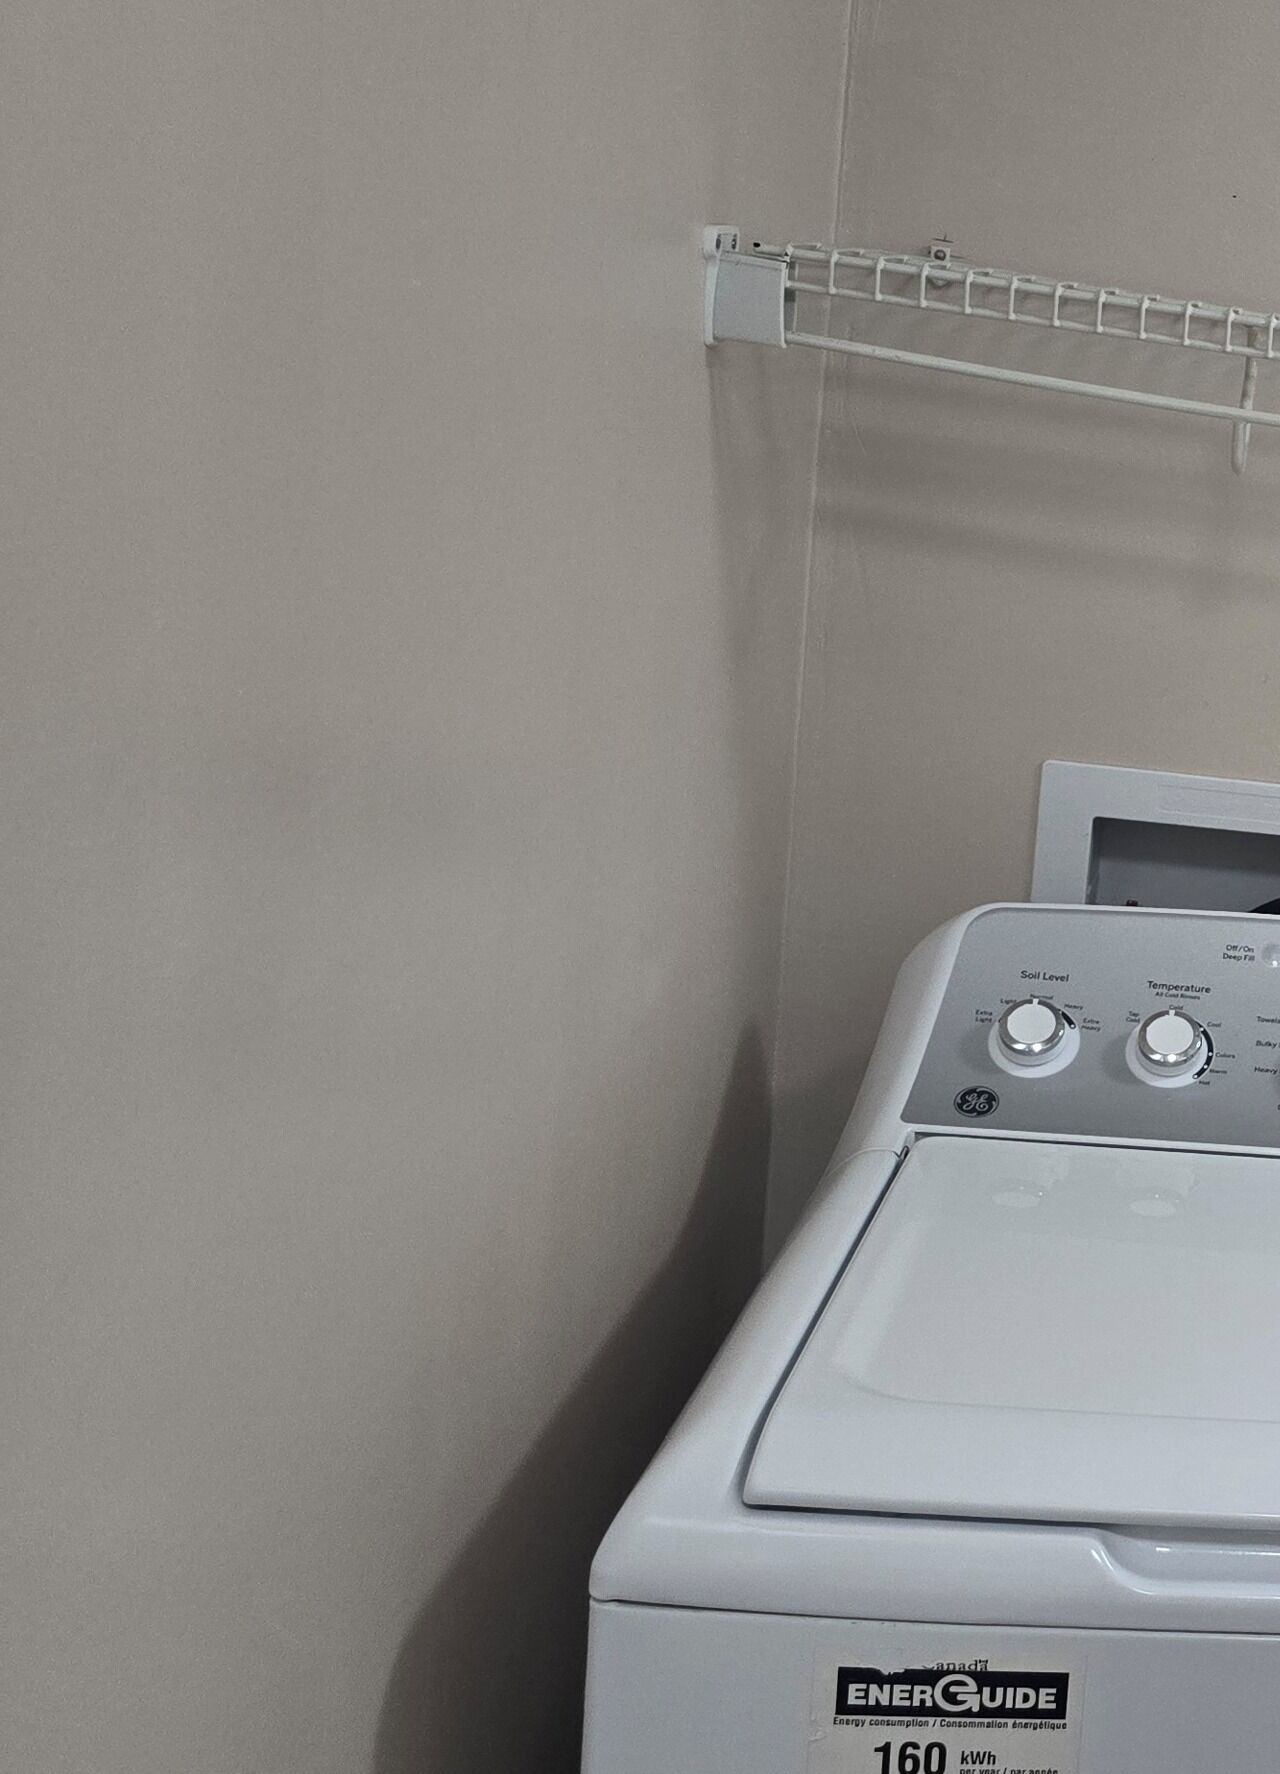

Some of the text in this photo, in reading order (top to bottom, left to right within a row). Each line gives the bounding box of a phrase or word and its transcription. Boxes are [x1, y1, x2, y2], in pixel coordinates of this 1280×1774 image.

[1225, 944, 1255, 954] Off/On
[1222, 952, 1256, 962] Deep Fill
[1020, 970, 1070, 982] Soil Level
[1146, 980, 1212, 994] Temperature
[1256, 1040, 1277, 1050] Bulky
[1254, 1066, 1278, 1076] Heavy
[922, 1659, 989, 1672] anada
[832, 1716, 866, 1728] Energy
[868, 1718, 930, 1730] consumption
[939, 1719, 1009, 1730] Consommation
[1012, 1719, 1068, 1731] énergétique
[873, 1740, 997, 1774] 160 kWh
